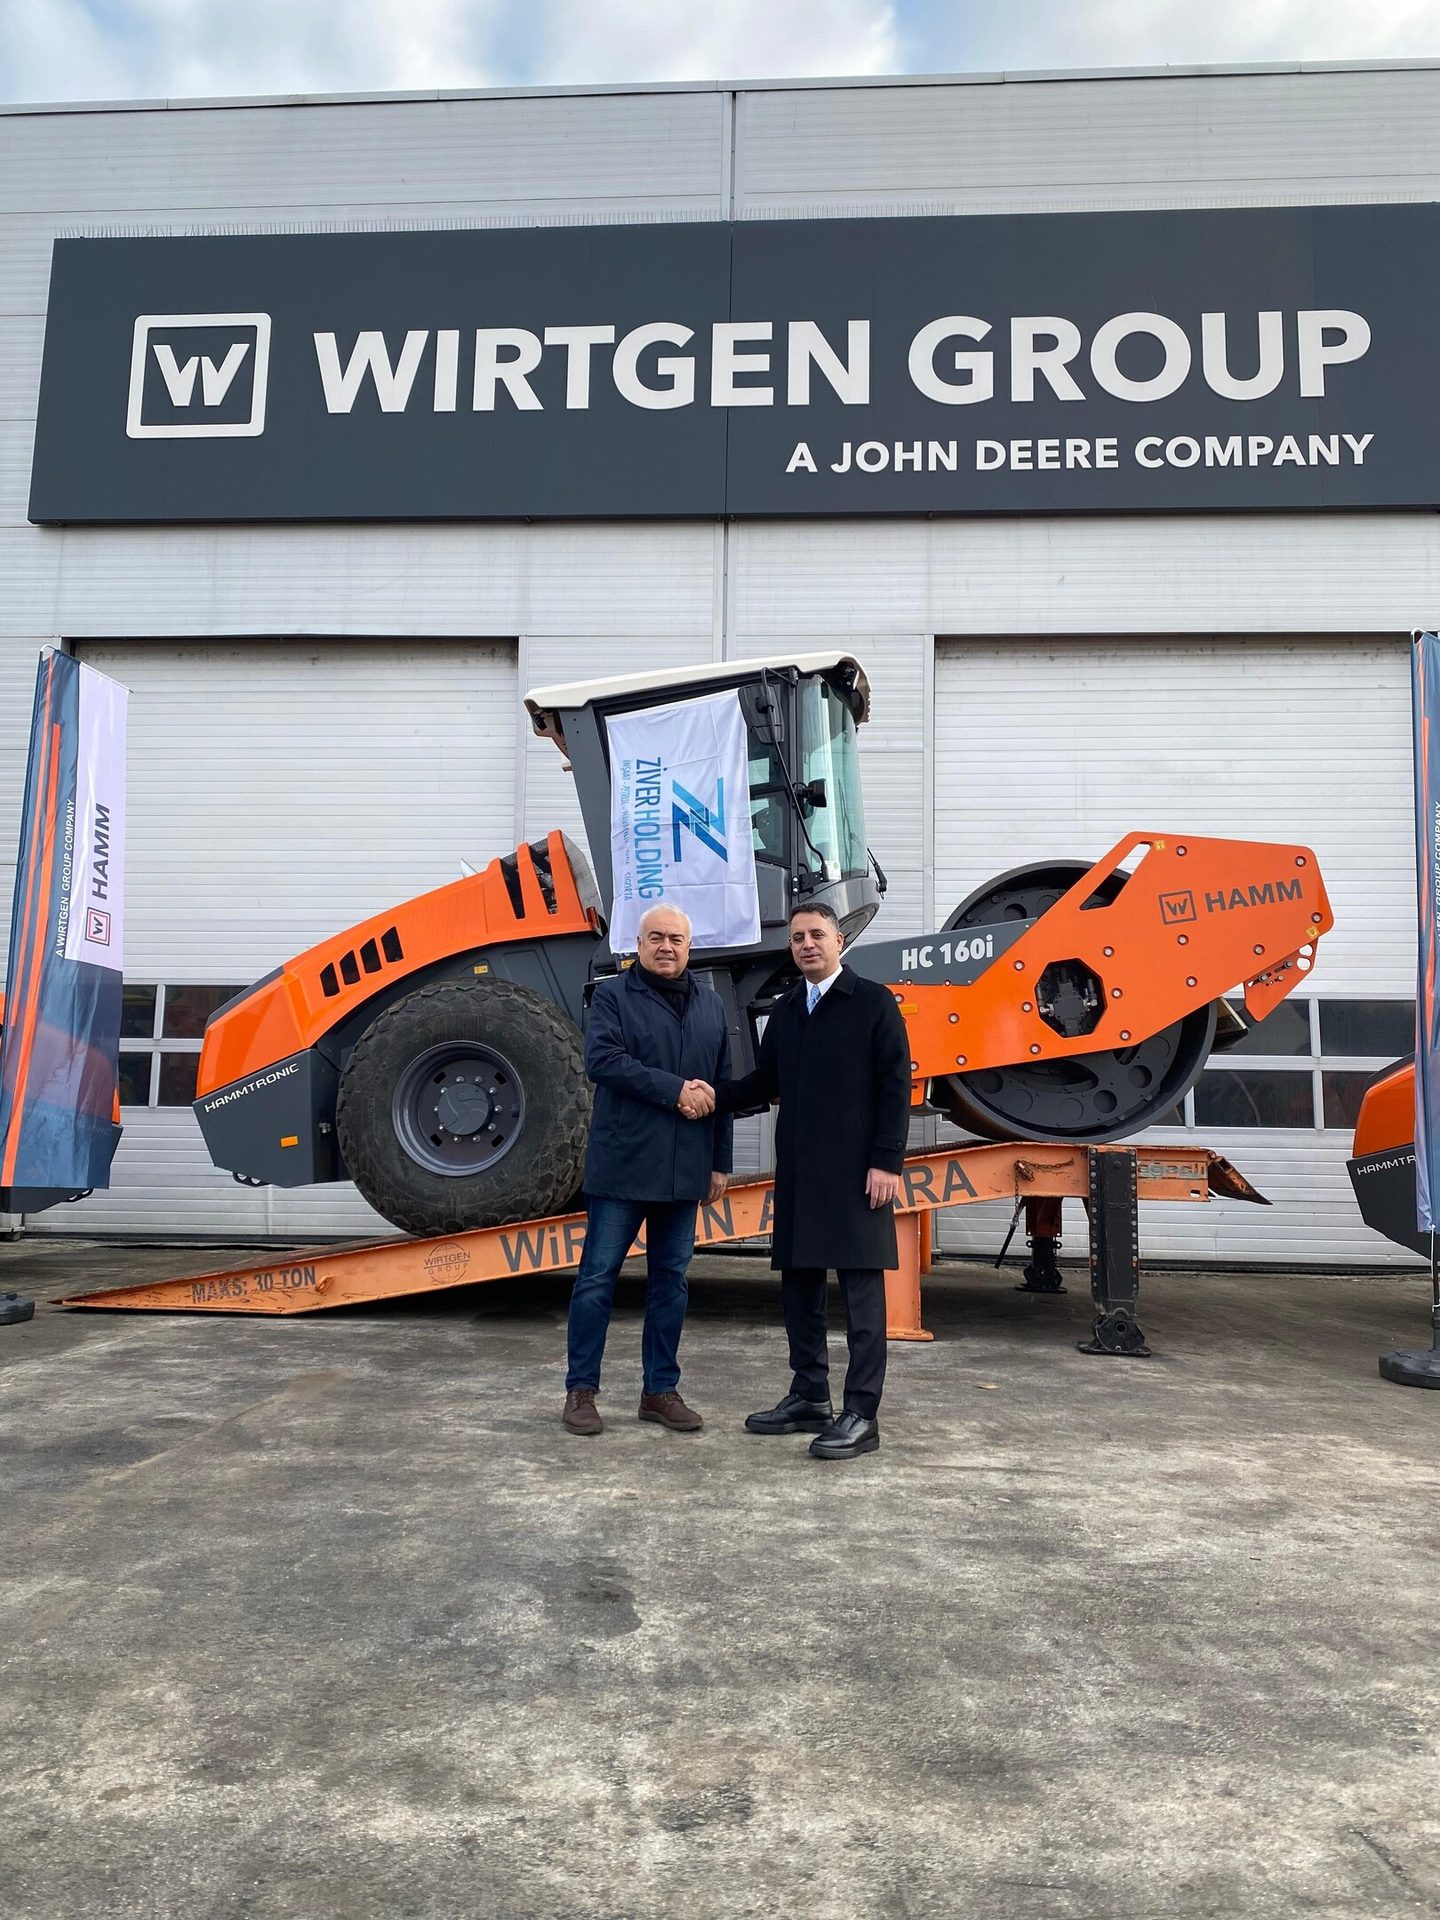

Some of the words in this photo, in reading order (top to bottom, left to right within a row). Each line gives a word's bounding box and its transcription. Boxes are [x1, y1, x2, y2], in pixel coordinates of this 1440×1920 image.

[314, 320, 870, 413] WIRTGEN
[909, 310, 1371, 404] GROUP
[786, 443, 817, 473] A
[831, 441, 957, 473] JOHN
[977, 438, 1119, 470] DEERE
[1135, 434, 1375, 468] COMPANY
[64, 799, 75, 850] COMPANY
[92, 803, 110, 900] HAMM
[634, 810, 669, 899] HOLDİNG
[62, 852, 73, 891] GROUP
[1205, 879, 1303, 913] HAMM
[56, 896, 69, 946] WIRTGEN
[56, 949, 64, 958] A
[902, 945, 934, 971] HC
[939, 933, 993, 965] 160i
[204, 1063, 300, 1113] HAMMTRONIC
[1357, 1154, 1416, 1176] HAMMTR
[279, 1266, 316, 1289] TON
[424, 1251, 471, 1266] WIRTGEN
[428, 1263, 468, 1275] GROUP
